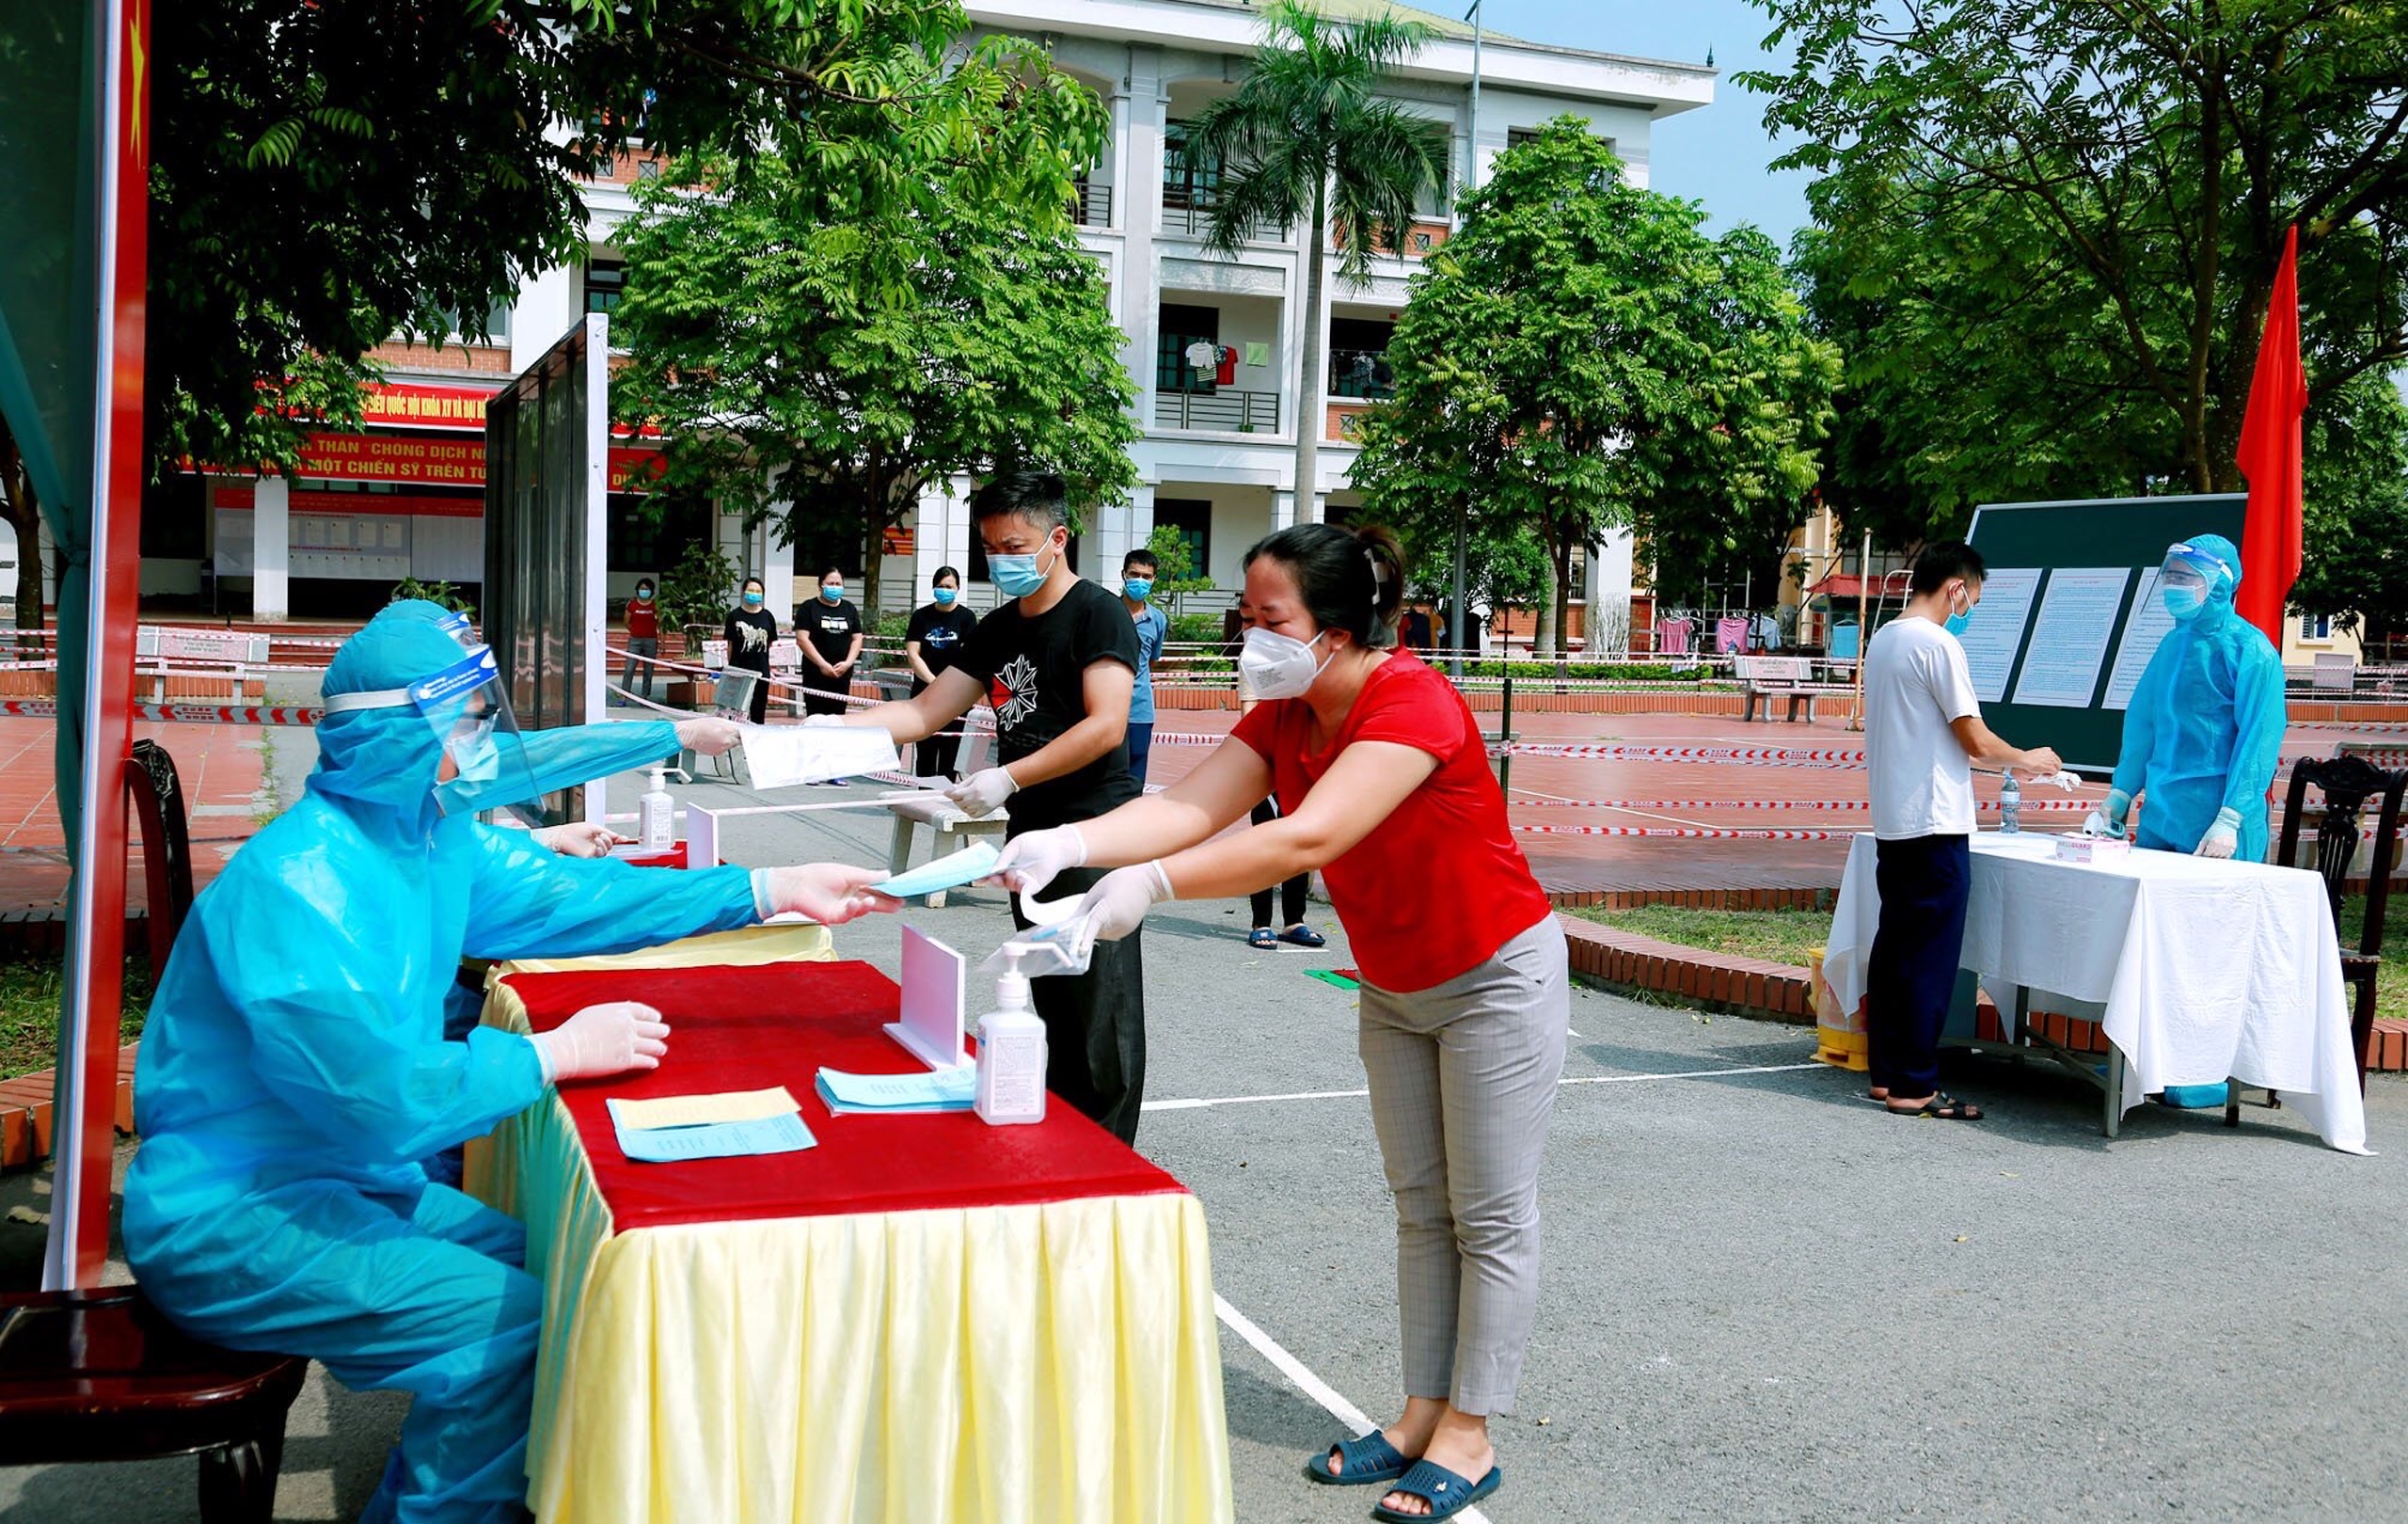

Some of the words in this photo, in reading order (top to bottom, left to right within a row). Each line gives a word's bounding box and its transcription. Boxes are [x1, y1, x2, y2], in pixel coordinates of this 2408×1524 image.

[387, 389, 406, 417] QUỐC
[407, 392, 420, 420] HỘI
[442, 398, 452, 418] XV
